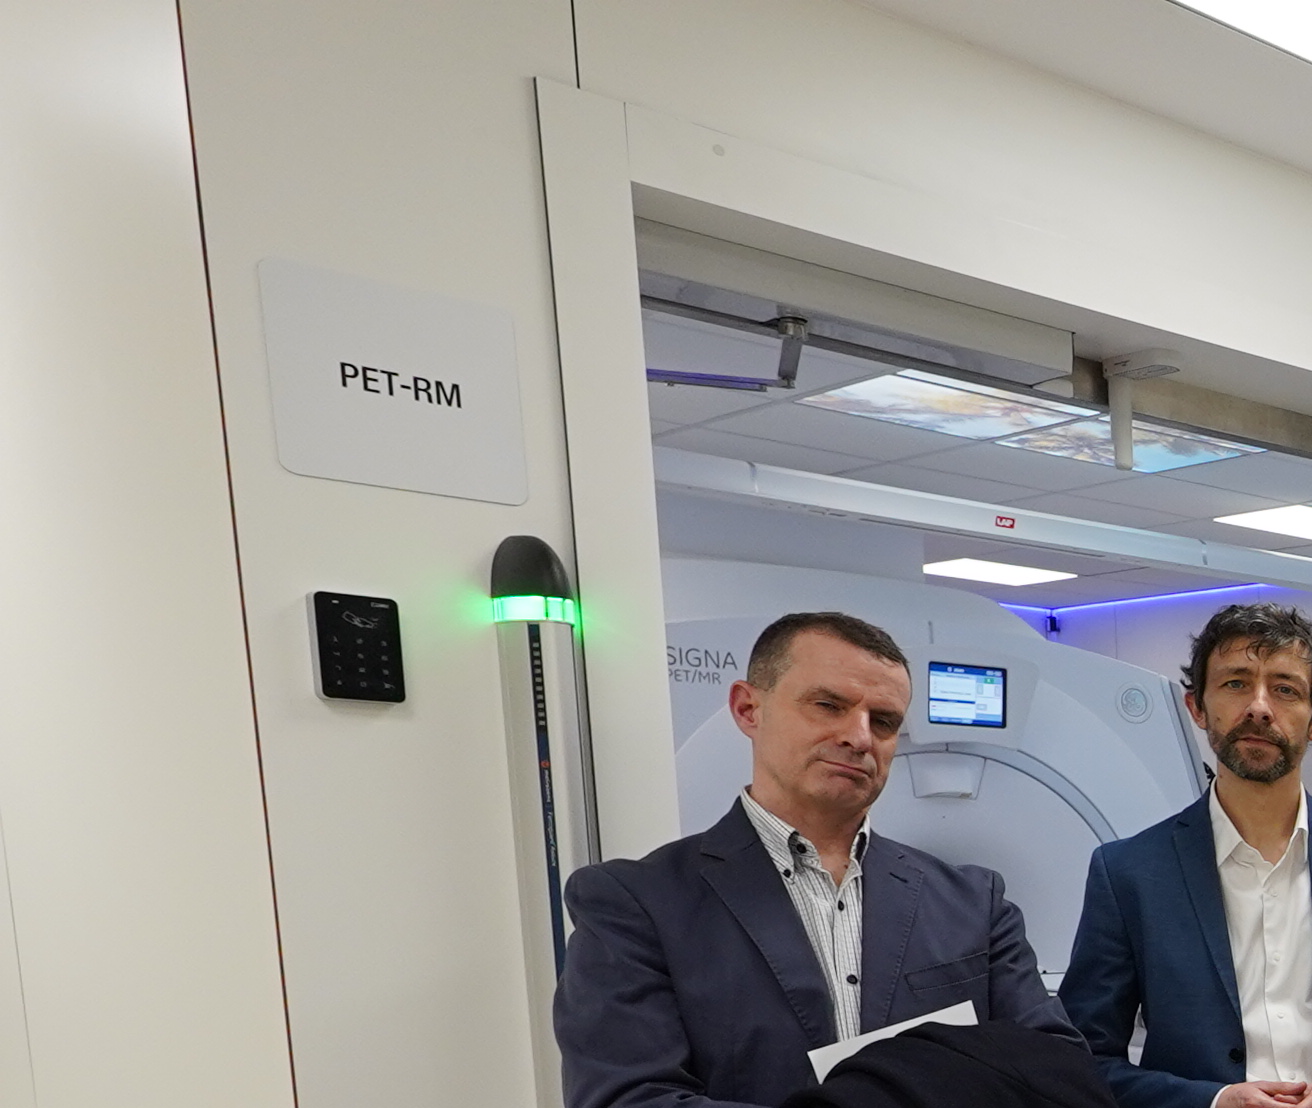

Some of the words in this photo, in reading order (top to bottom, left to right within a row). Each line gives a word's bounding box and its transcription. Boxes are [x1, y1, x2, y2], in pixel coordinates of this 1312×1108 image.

[339, 361, 462, 409] PET-RM
[666, 645, 738, 671] SIGNA
[668, 668, 722, 685] PET/MR
